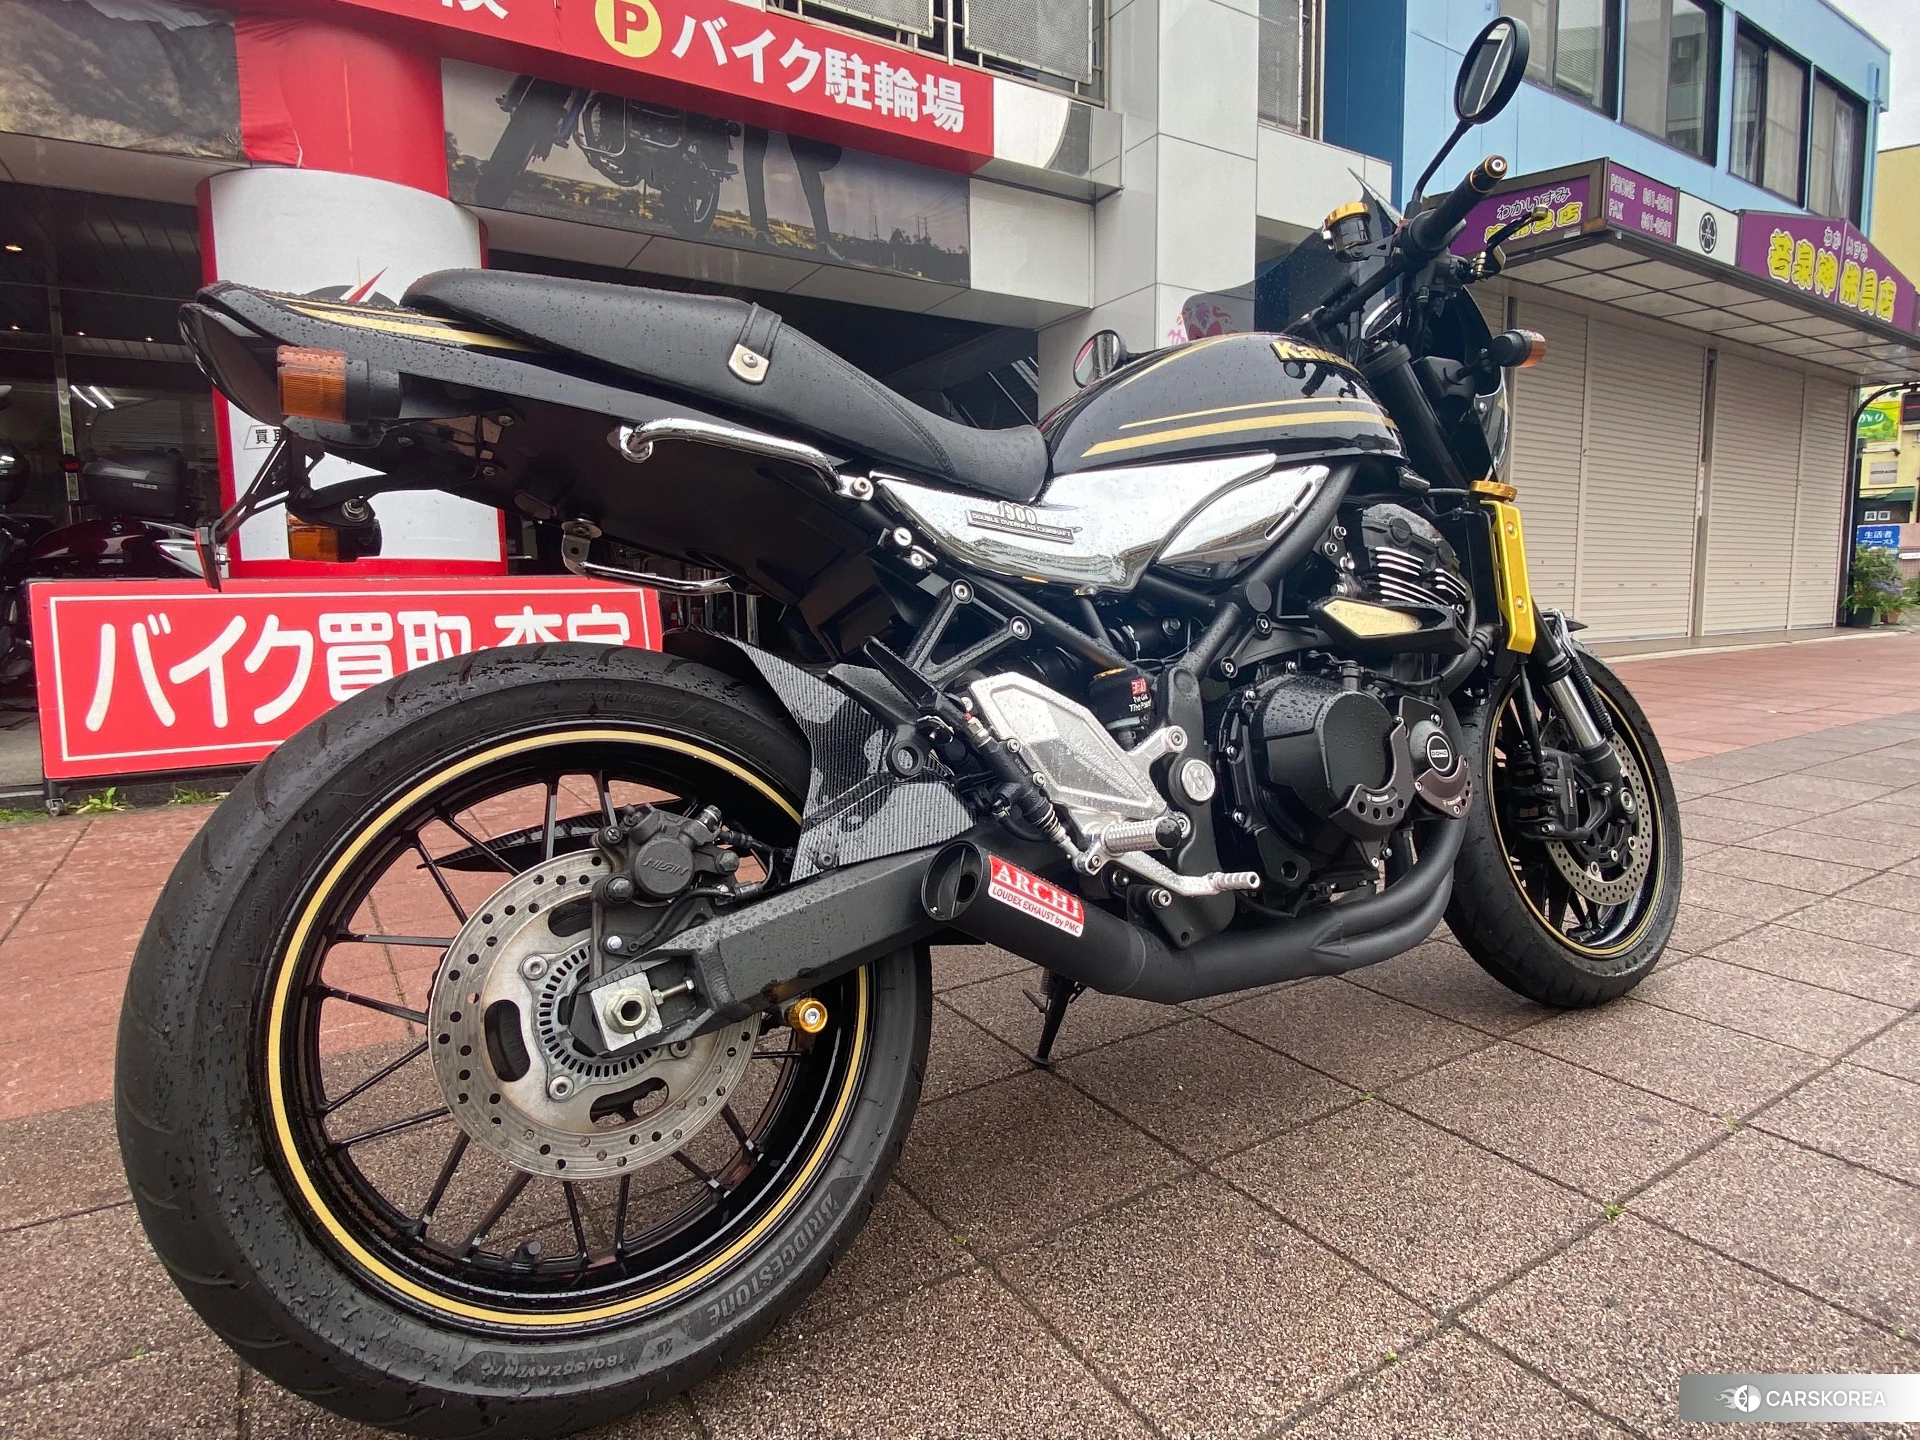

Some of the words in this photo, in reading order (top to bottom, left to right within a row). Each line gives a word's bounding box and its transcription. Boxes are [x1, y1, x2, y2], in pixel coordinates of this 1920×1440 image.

[613, 0, 649, 44] P
[671, 15, 964, 132] バイク駐輪場
[1609, 198, 1624, 220] FAX
[1611, 174, 1635, 200] PHONE
[972, 513, 1000, 524] DOUBLE
[992, 886, 1022, 907] LOUDEX
[1022, 901, 1055, 921] EXHAUST
[1055, 914, 1064, 927] by
[1064, 920, 1080, 934] PMC
[706, 1191, 840, 1326] BRIDGESTONE
